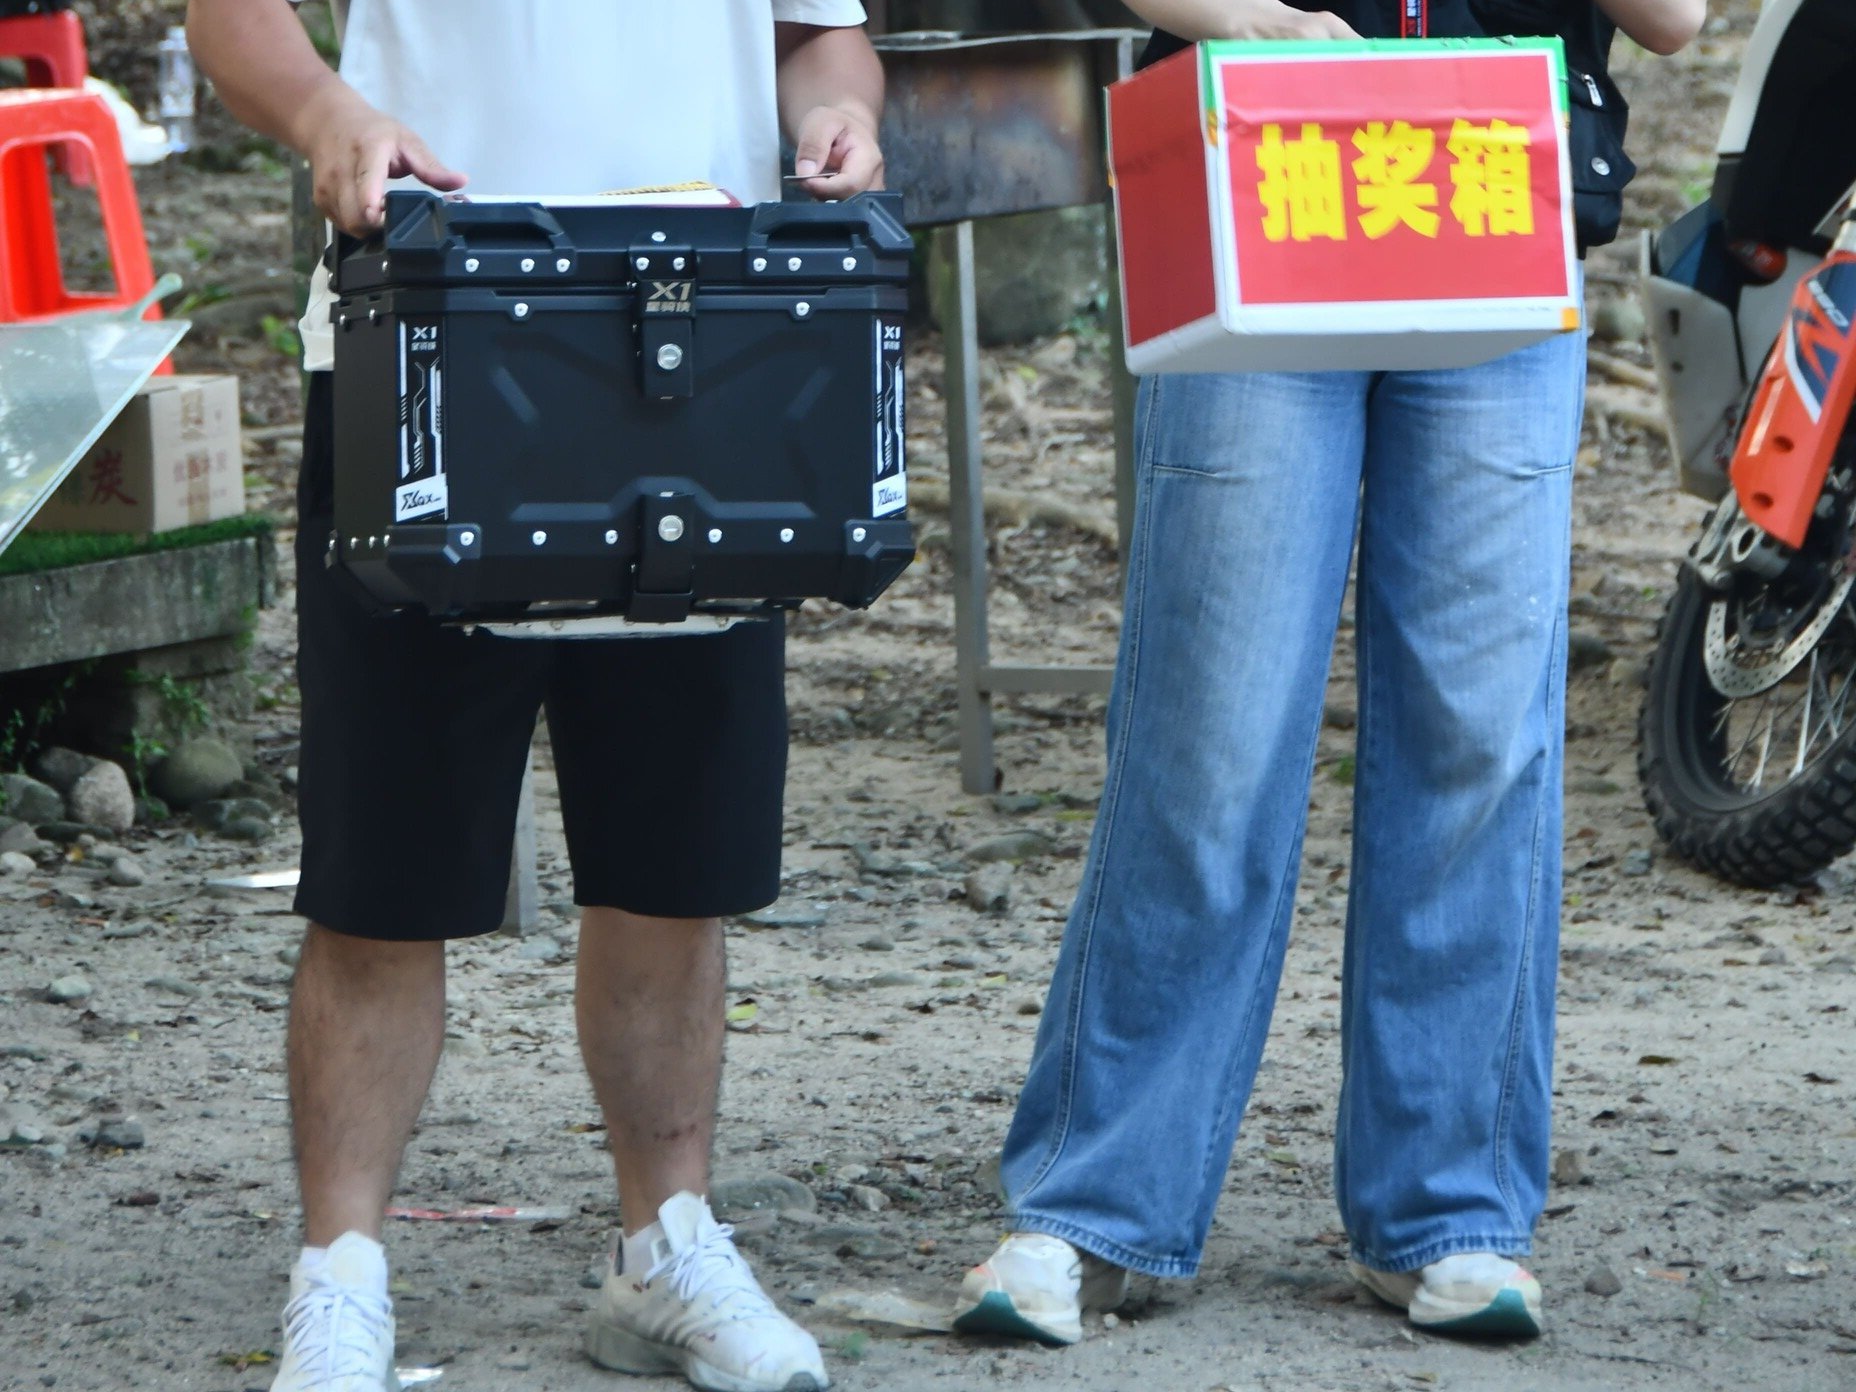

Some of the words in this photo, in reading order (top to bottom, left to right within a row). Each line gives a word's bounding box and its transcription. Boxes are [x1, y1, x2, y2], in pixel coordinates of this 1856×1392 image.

[1255, 118, 1535, 242] 抽奖箱
[648, 281, 692, 301] X1
[412, 325, 438, 340] X1
[884, 325, 902, 340] X1
